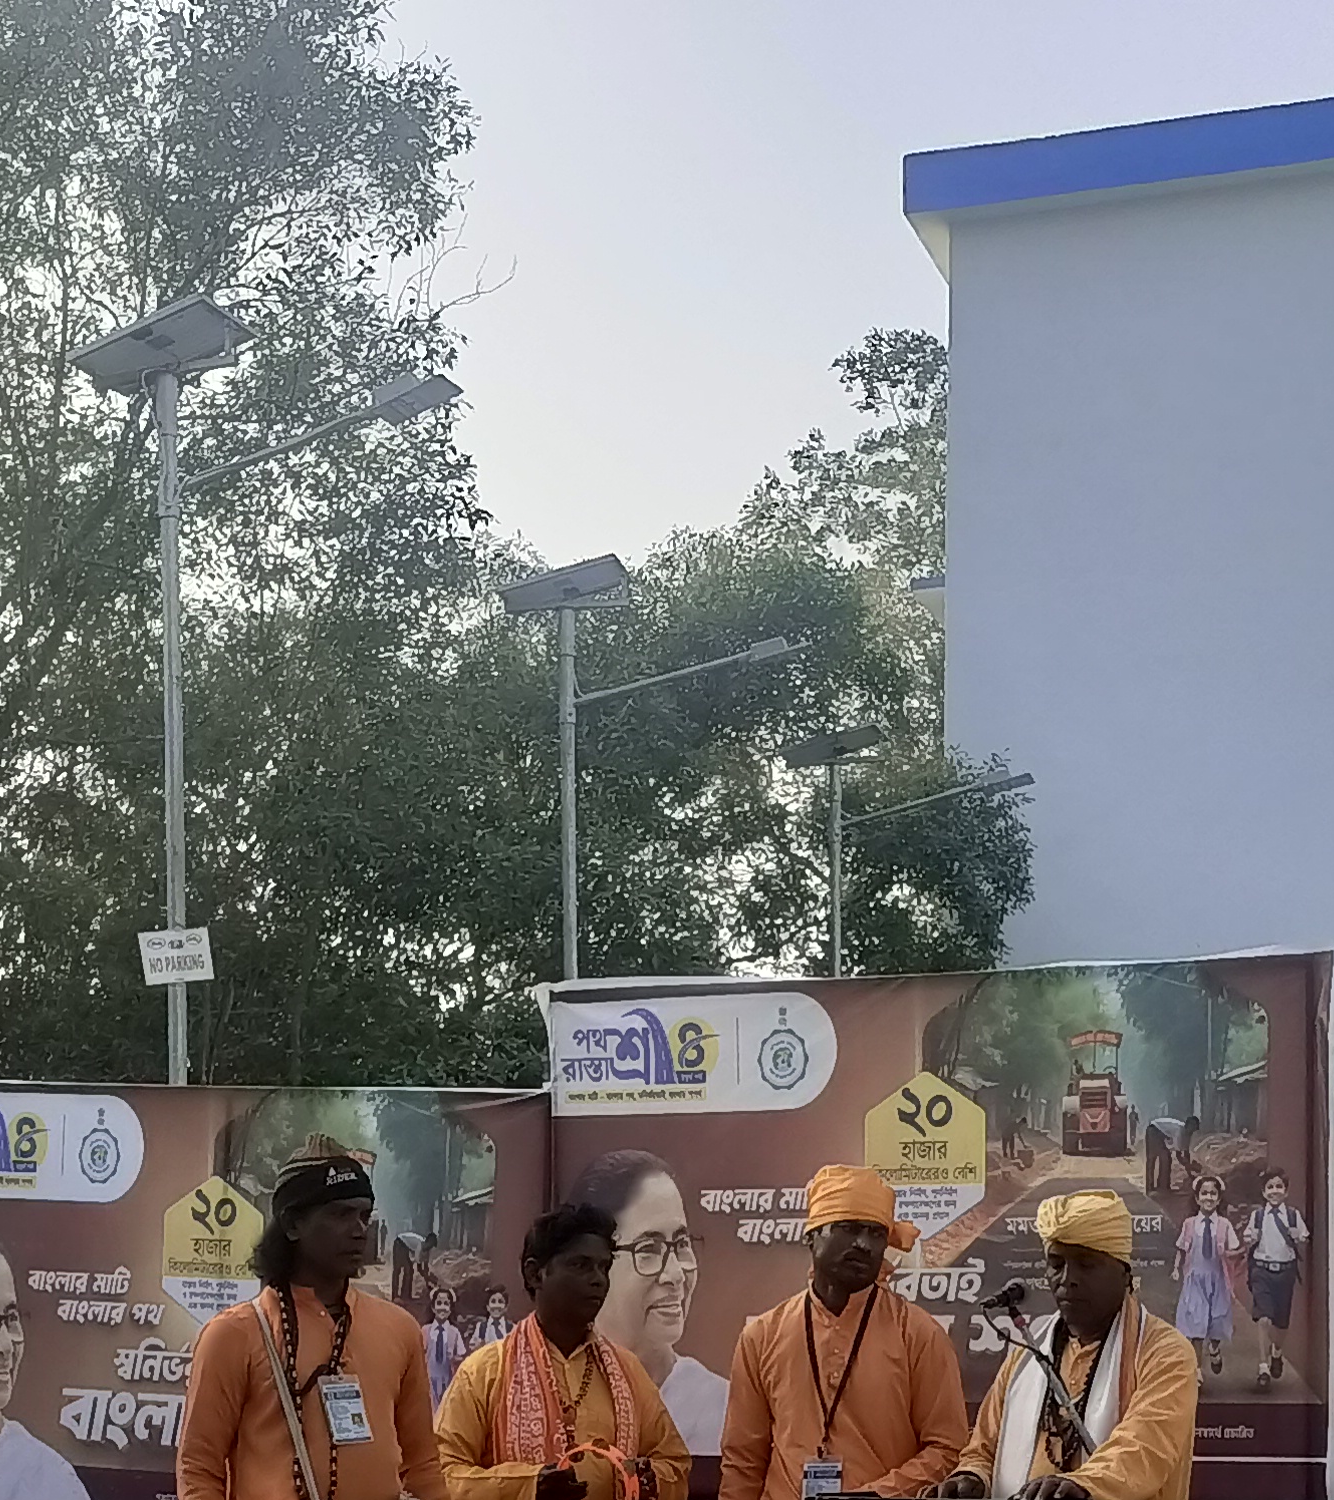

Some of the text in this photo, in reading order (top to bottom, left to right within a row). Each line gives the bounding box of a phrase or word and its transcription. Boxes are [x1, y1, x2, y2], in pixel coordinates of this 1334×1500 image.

[897, 1087, 953, 1137] ২০
[899, 1139, 948, 1162] হাজার
[191, 1189, 237, 1235] ২০
[700, 1188, 773, 1214] বাংলার
[190, 1237, 232, 1258] হাজার
[28, 1265, 131, 1295] বাংলার মাটি
[57, 1299, 165, 1326] বাংলার পথ
